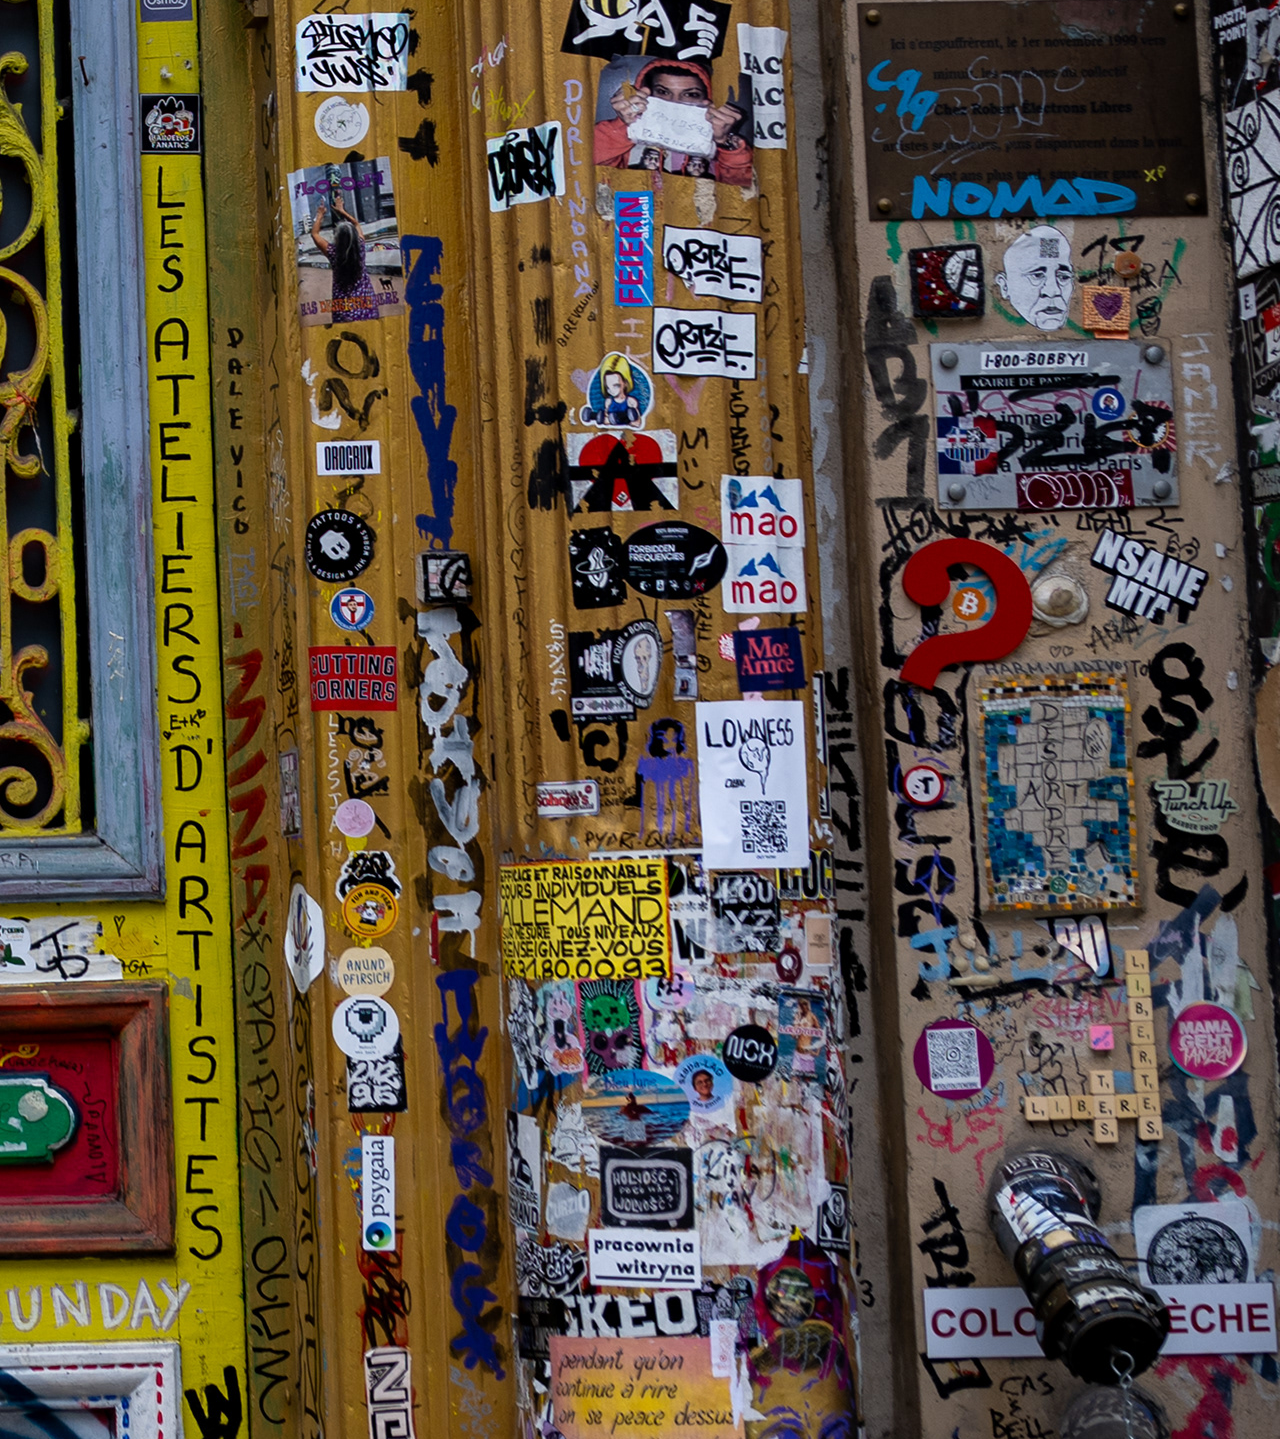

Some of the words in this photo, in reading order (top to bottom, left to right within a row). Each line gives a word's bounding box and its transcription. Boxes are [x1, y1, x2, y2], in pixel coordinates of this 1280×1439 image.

[1108, 34, 1139, 48] 1999
[909, 173, 1138, 220] NOMAD
[154, 165, 185, 294] LES
[617, 194, 641, 305] FEIERN
[971, 376, 1016, 389] MAIRIE
[1018, 375, 1036, 388] DE
[153, 317, 202, 706] ATELIERS
[313, 514, 355, 531] TATTOOS
[729, 508, 798, 538] mao
[628, 543, 676, 554] FORBIDDEN
[628, 552, 686, 563] FREQUENCIES
[1092, 527, 1209, 608] NSANE
[731, 577, 798, 606] mao
[310, 651, 397, 679] CUTTING
[705, 716, 795, 749] LOWNESS
[552, 863, 662, 881] RAISONNABLE
[536, 879, 663, 900] INDIVIDUELS
[502, 896, 664, 927] ALLEMAND
[557, 925, 591, 940] TOUS
[594, 923, 666, 940] NIVEAUX
[502, 938, 665, 959] RENSEIGNEZ-VOUS
[1179, 1019, 1234, 1037] MAMA
[1179, 1033, 1234, 1049] GEHT
[370, 1138, 394, 1219] psygaia
[592, 1236, 696, 1259] pracownia
[616, 1258, 696, 1284] witryna
[640, 1379, 678, 1401] rire
[585, 1410, 604, 1427] se
